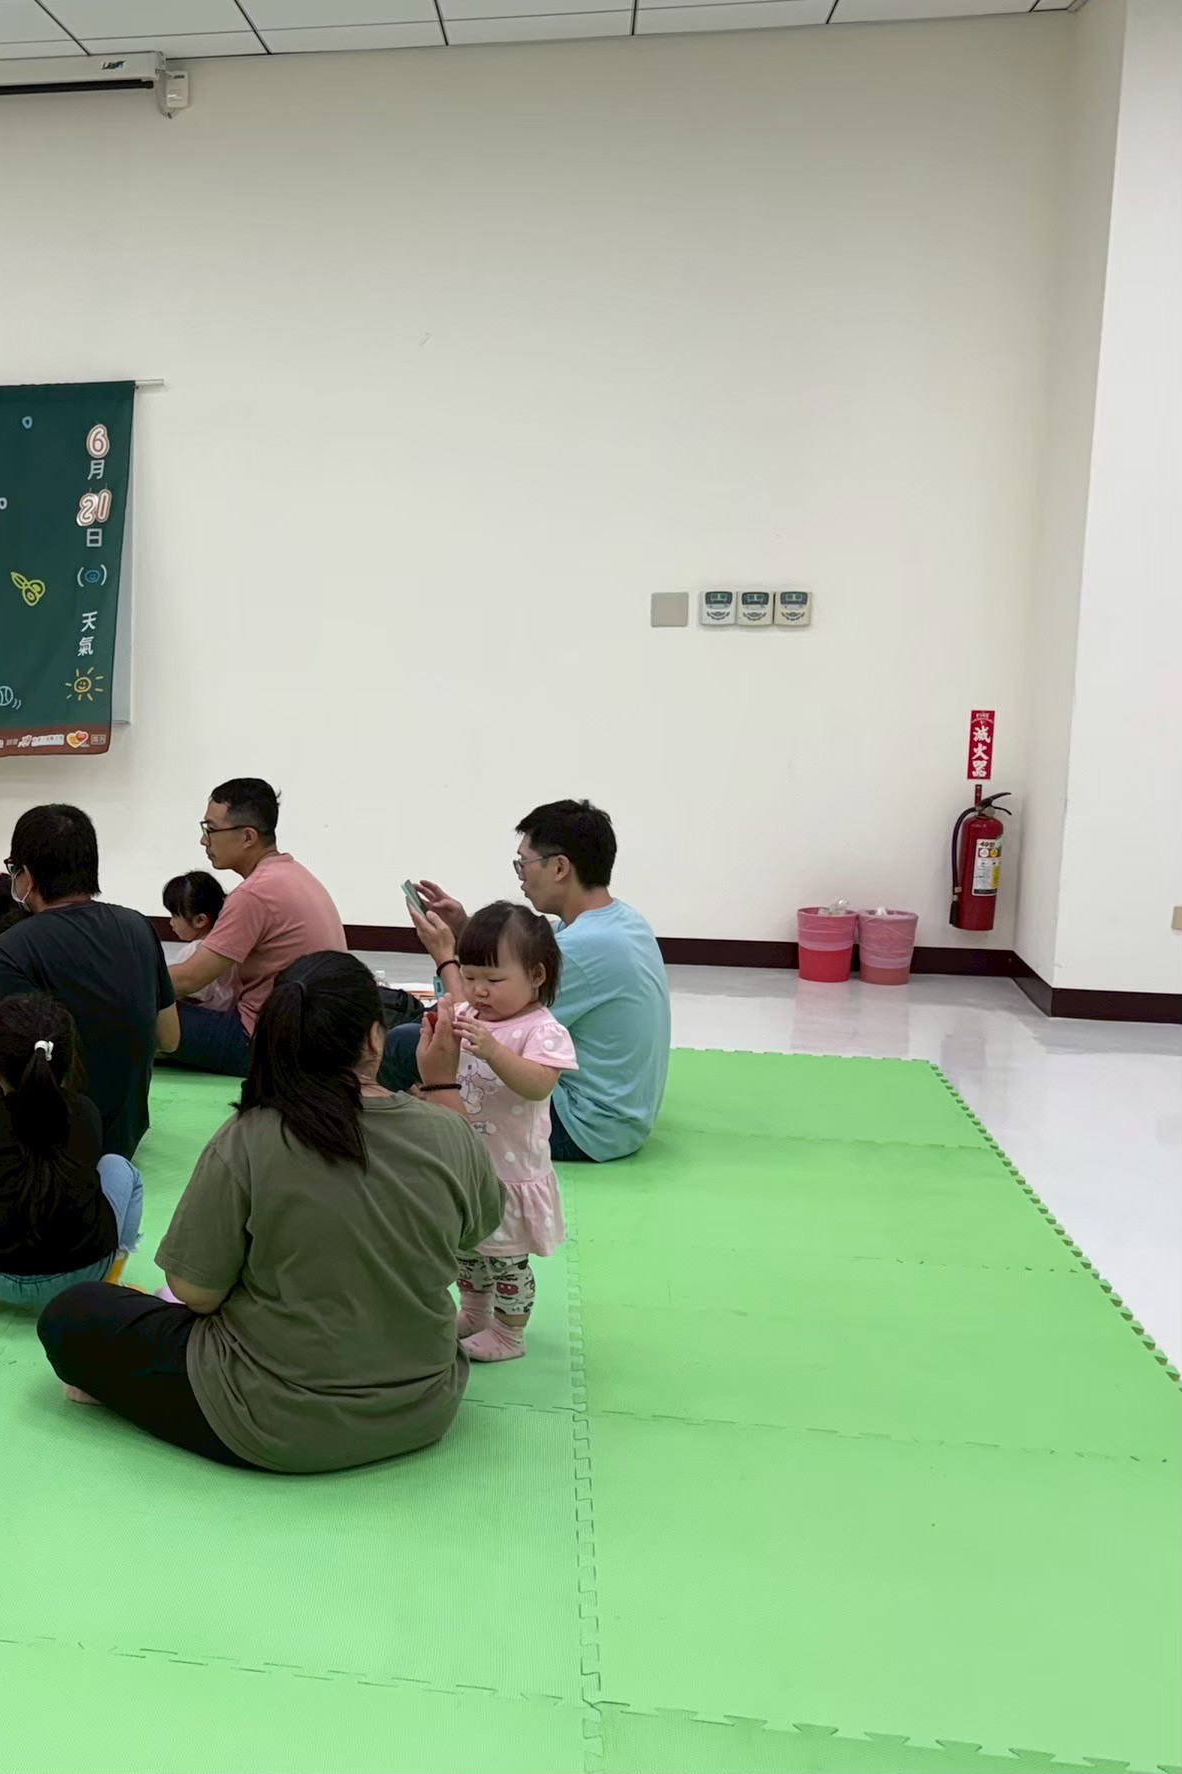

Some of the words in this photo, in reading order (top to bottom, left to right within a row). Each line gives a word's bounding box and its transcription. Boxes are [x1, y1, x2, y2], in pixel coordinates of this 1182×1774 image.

[77, 611, 98, 657] 天氣
[971, 725, 992, 778] 滅火器
